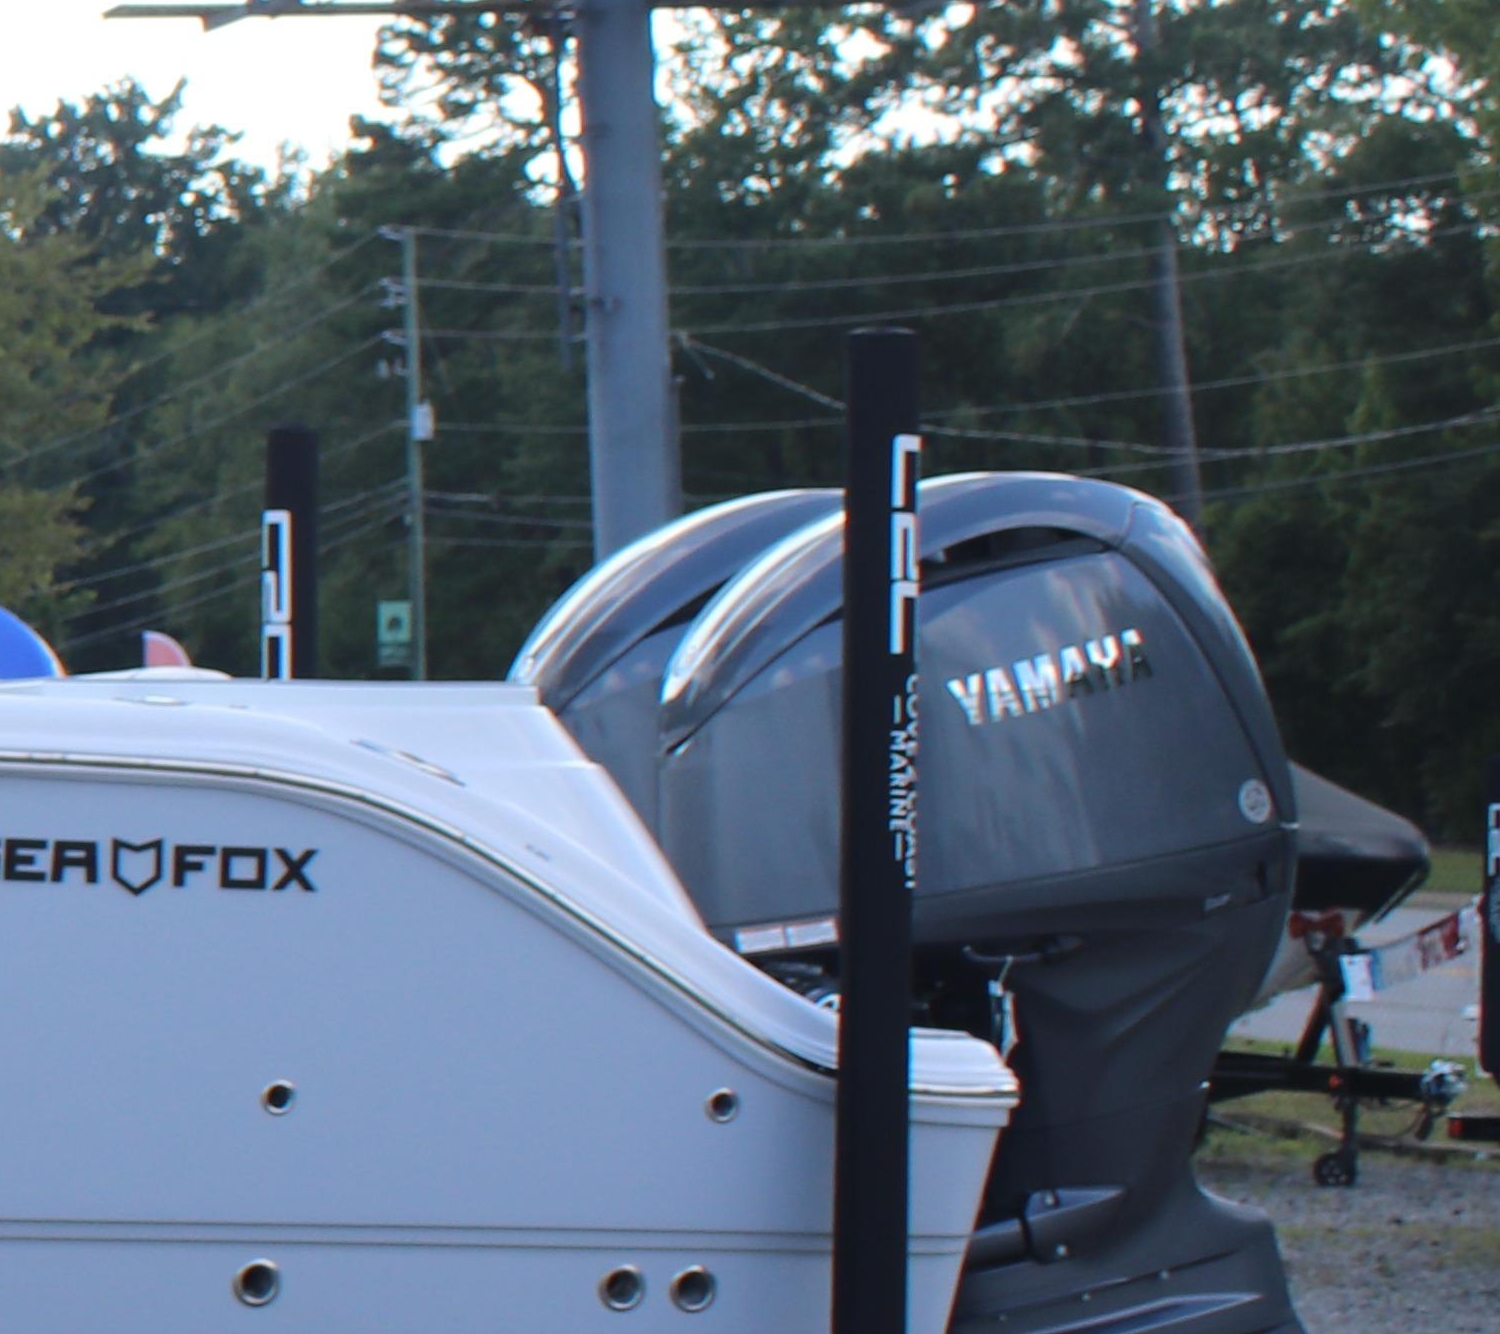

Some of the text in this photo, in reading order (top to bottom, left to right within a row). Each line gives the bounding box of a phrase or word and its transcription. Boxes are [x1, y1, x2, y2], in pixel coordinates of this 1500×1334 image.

[946, 628, 1155, 727] YAMAHA
[888, 729, 909, 832] MARINE
[170, 844, 320, 893] FOX
